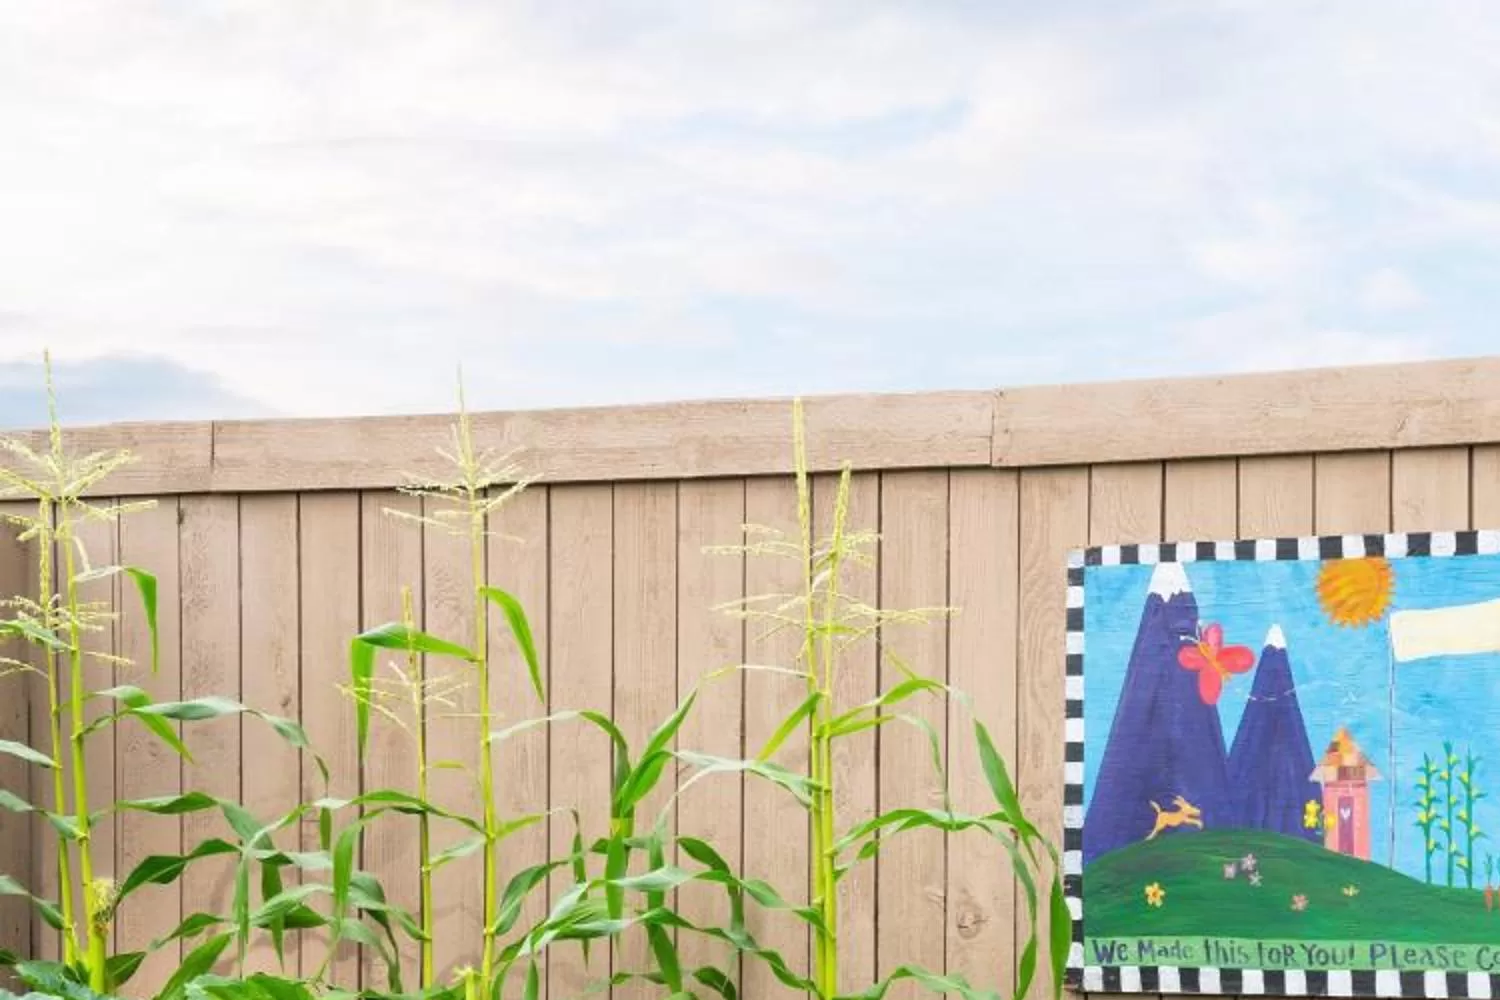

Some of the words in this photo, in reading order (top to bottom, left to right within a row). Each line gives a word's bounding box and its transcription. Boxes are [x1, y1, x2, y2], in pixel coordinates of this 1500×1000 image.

[1092, 938, 1129, 964] We
[1137, 939, 1194, 963] Made
[1300, 943, 1355, 967] You!
